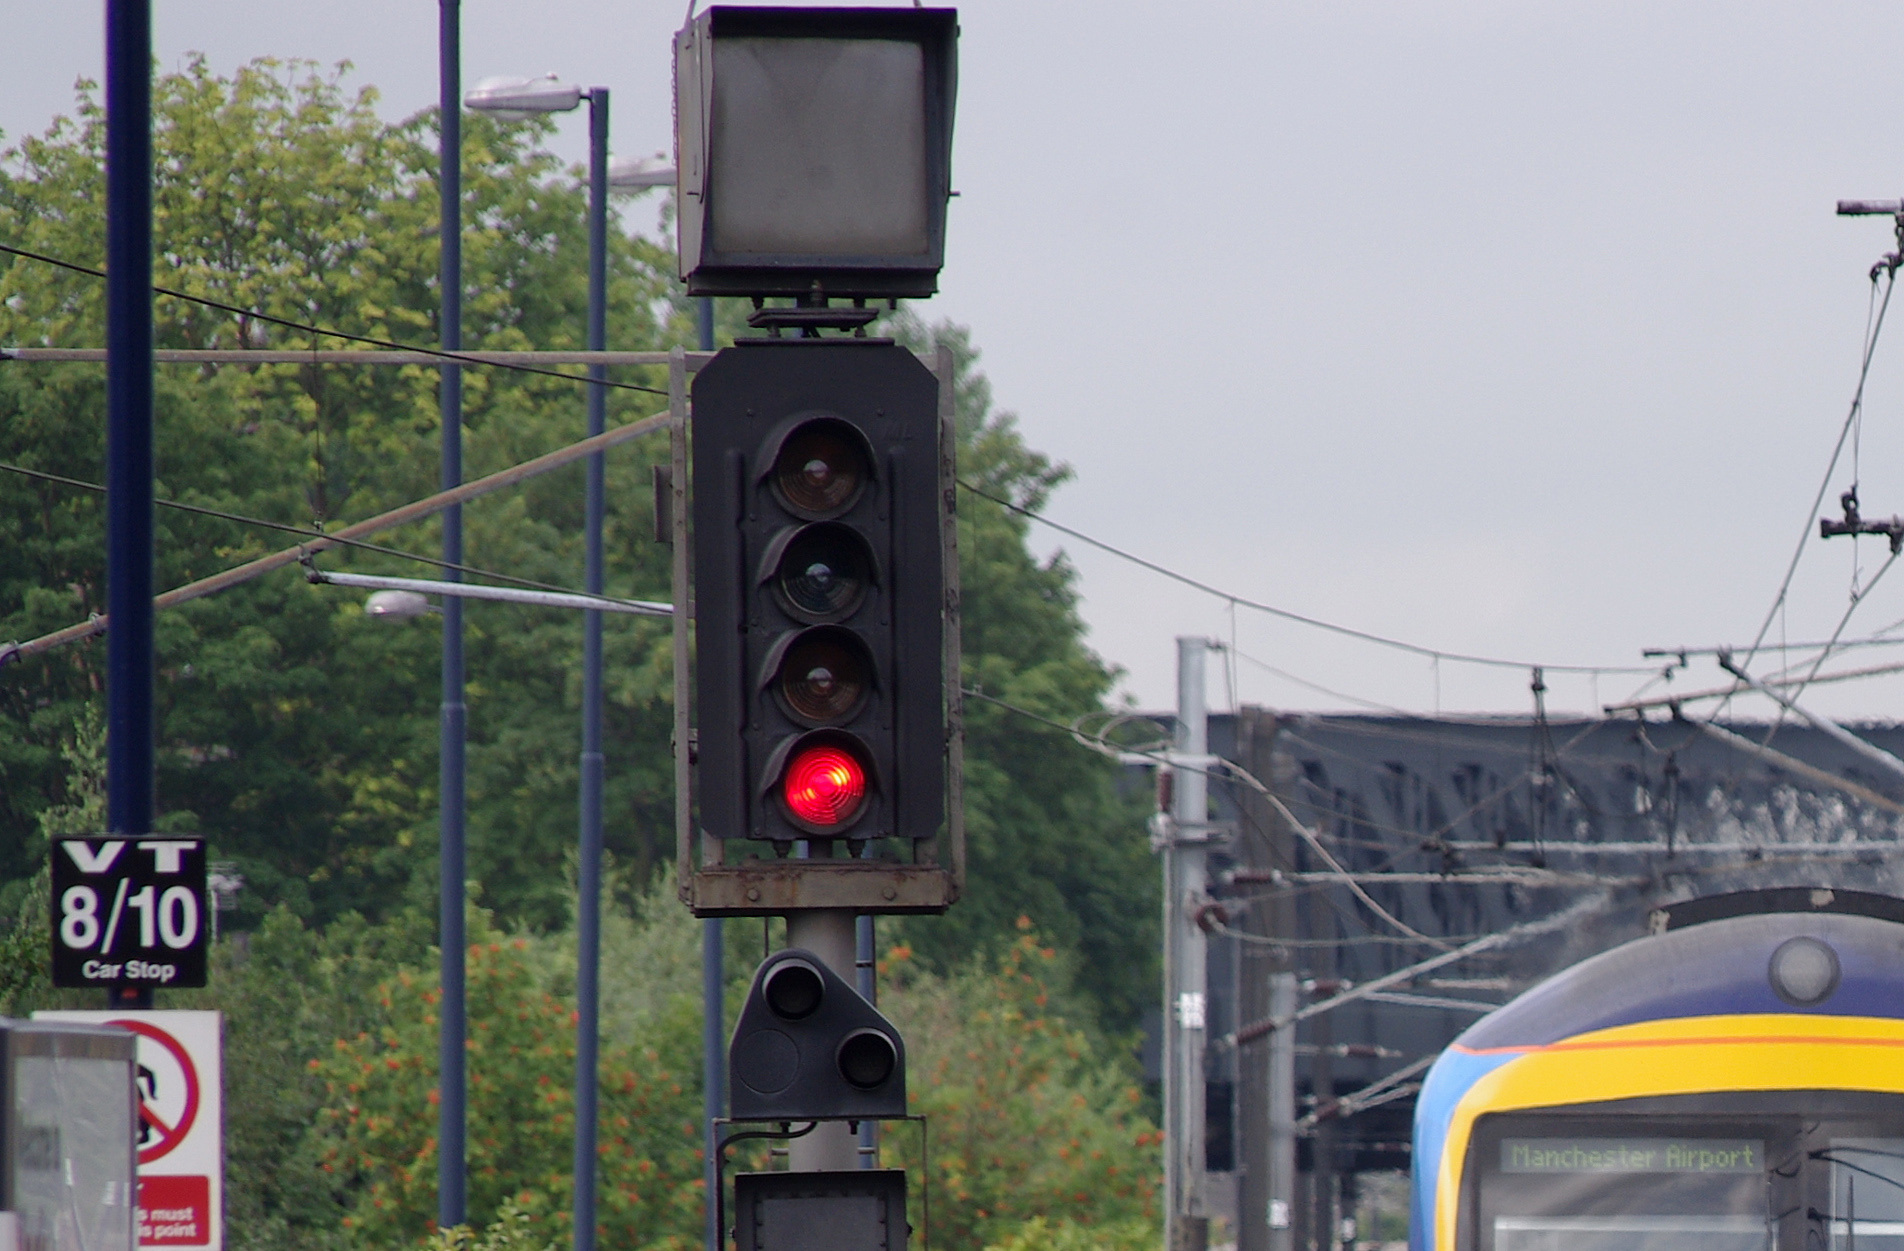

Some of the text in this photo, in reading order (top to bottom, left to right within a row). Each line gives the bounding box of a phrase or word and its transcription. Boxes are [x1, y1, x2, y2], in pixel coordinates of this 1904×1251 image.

[60, 877, 199, 954] 8/10
[83, 959, 176, 983] Car Stop
[1511, 1144, 1754, 1172] Manchester Airport
[150, 1207, 193, 1221] must
[154, 1223, 196, 1239] point
